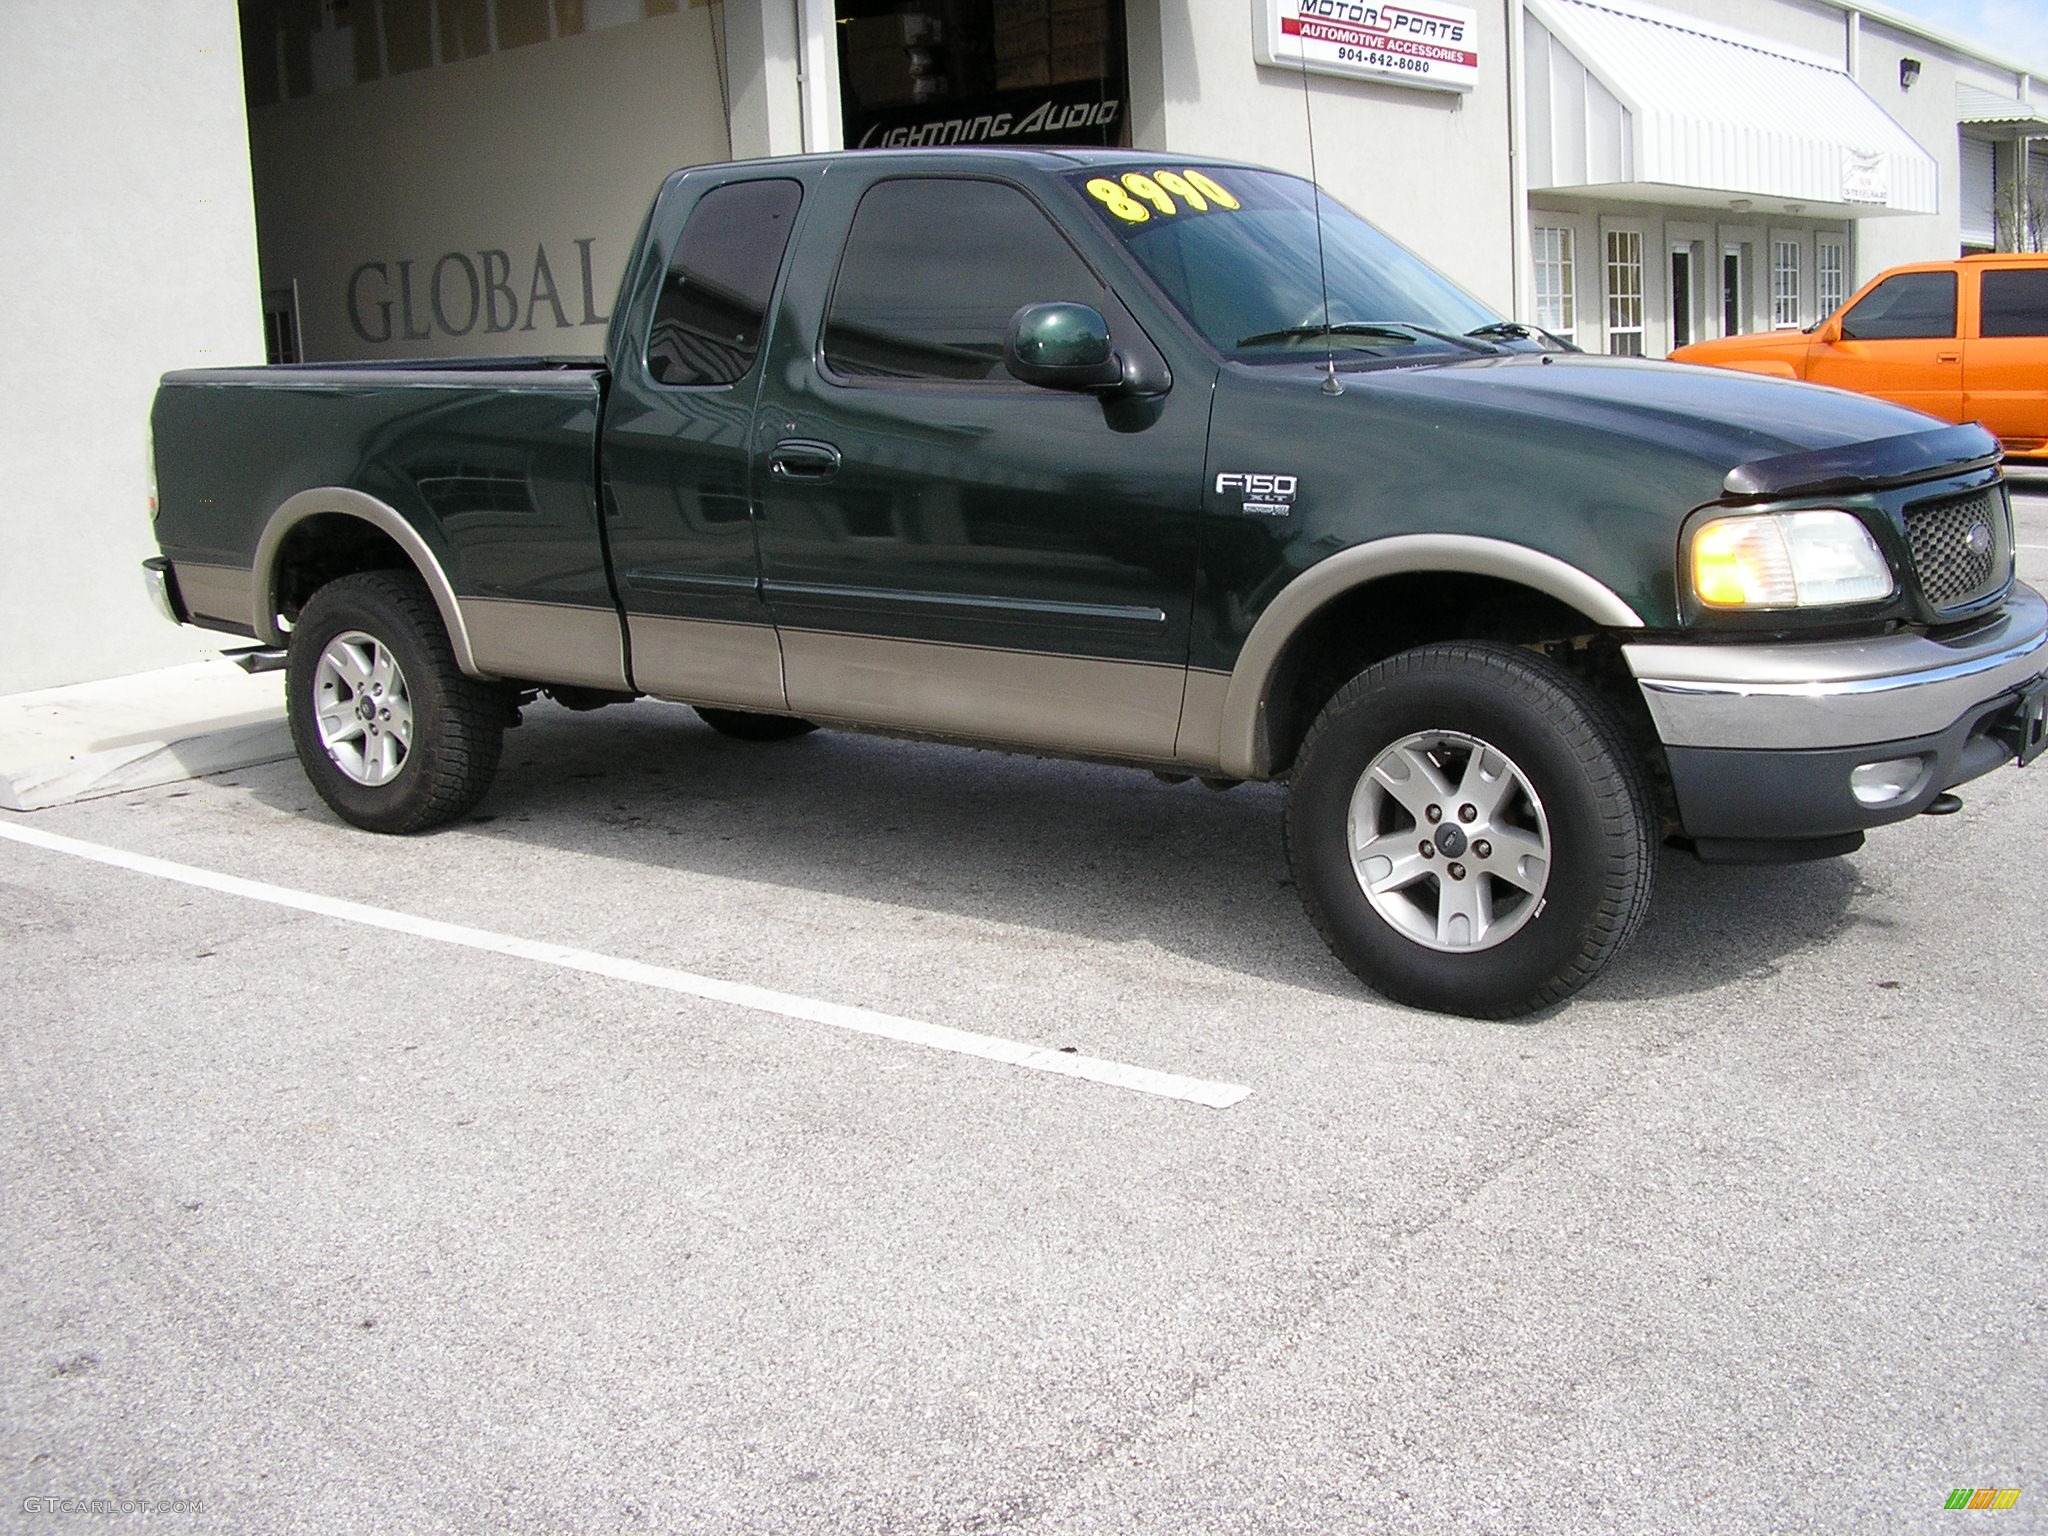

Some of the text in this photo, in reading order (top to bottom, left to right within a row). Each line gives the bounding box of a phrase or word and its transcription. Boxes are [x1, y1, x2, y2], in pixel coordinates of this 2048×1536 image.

[1301, 23, 1465, 63] AUTOMOTIVE ACCESSORIES
[1011, 100, 1119, 135] AUDIO
[1086, 169, 1241, 222] 8990
[347, 238, 611, 343] GLOBAL
[1249, 494, 1288, 502] XLT
